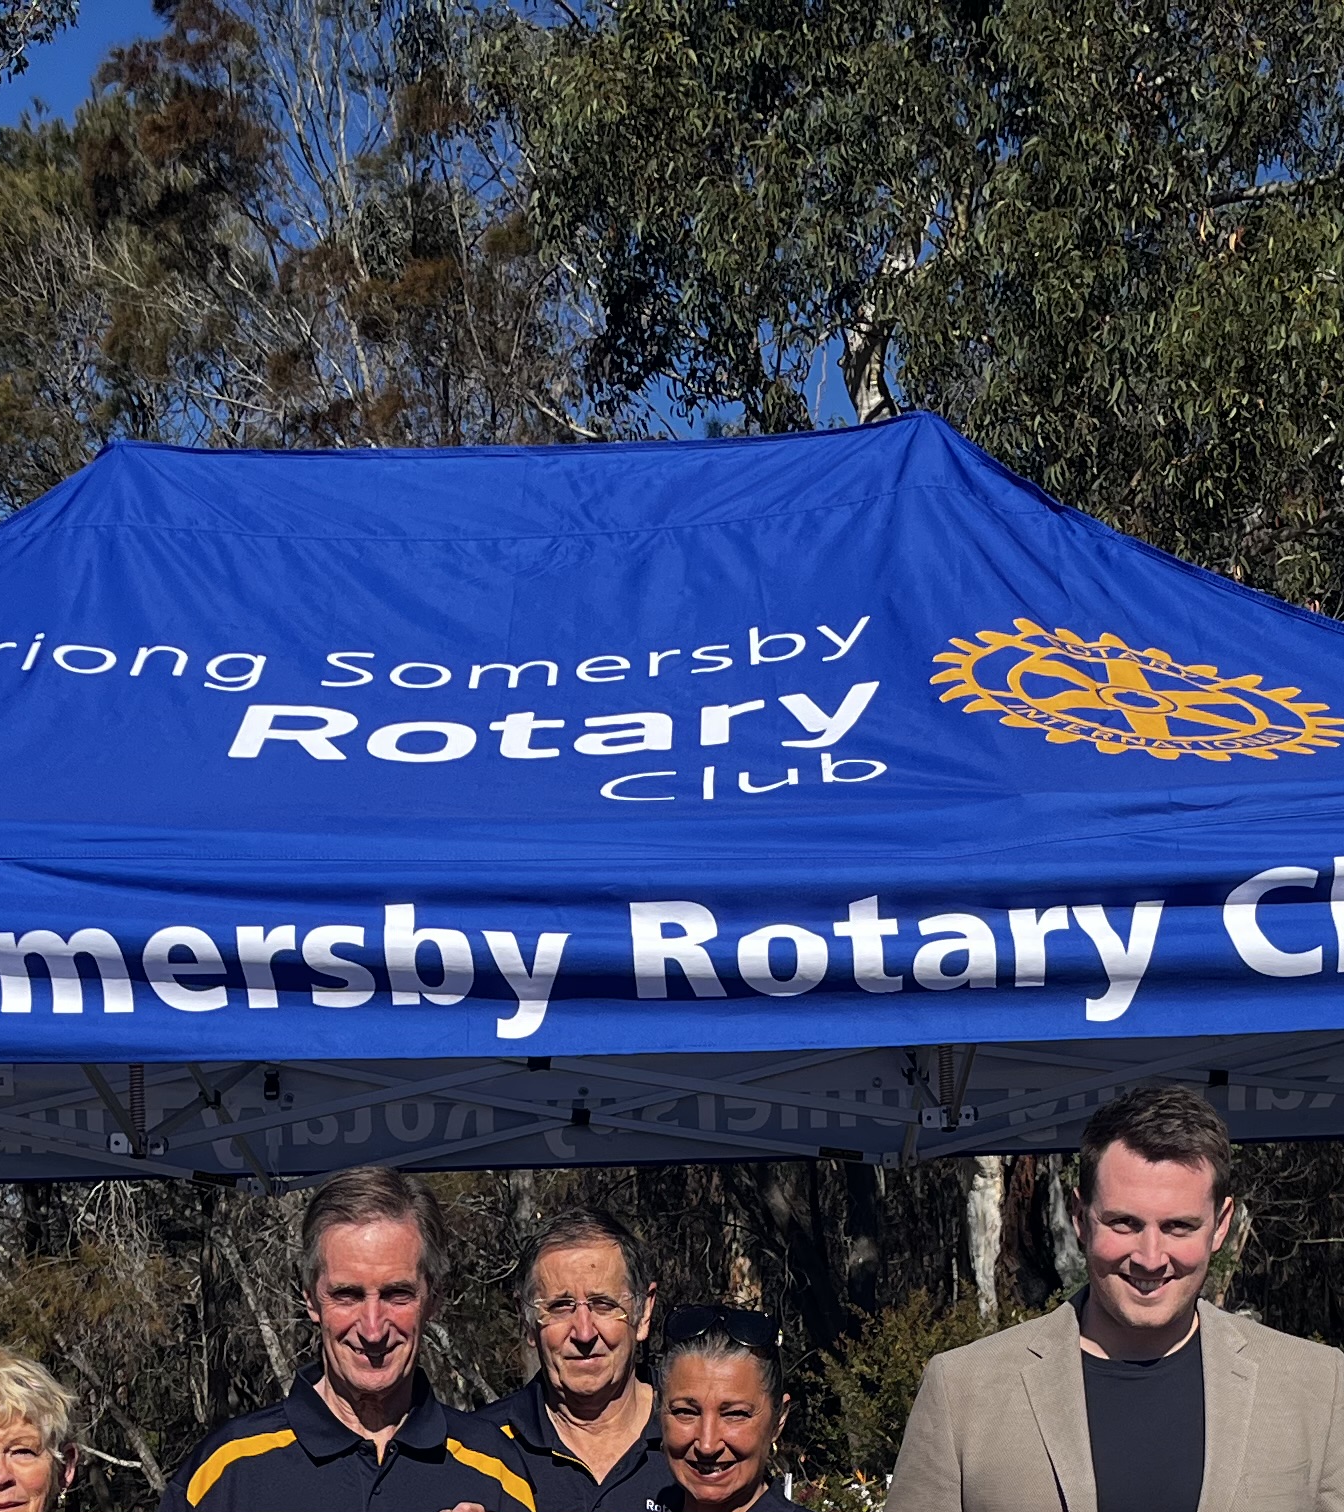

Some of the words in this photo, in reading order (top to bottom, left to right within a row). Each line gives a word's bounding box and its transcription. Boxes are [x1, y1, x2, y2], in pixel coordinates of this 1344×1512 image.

[321, 615, 870, 690] Somersby
[1044, 635, 1201, 679] ROTARY
[227, 681, 879, 762] Rotary
[1007, 703, 1293, 749] INTERNATIONAL
[599, 752, 887, 800] Club
[629, 894, 1164, 1023] Rotary
